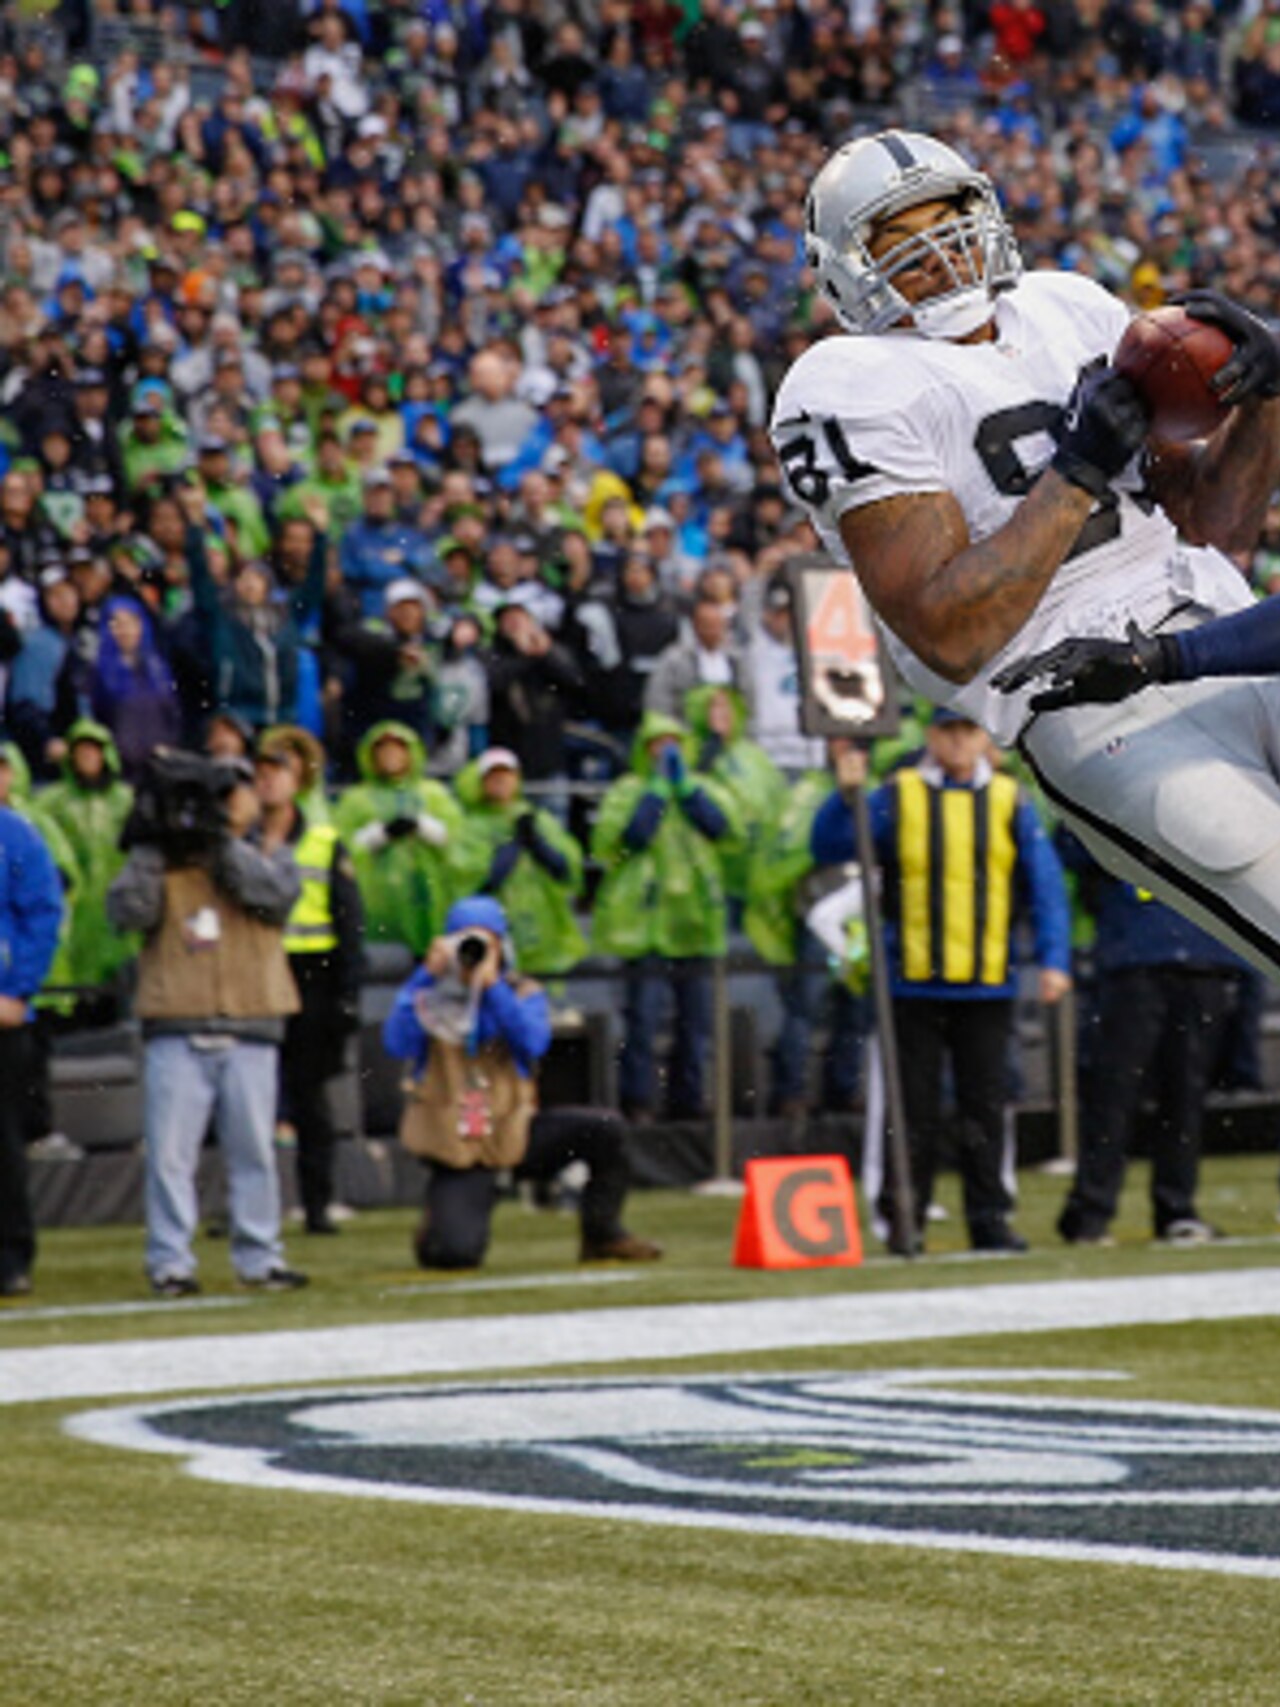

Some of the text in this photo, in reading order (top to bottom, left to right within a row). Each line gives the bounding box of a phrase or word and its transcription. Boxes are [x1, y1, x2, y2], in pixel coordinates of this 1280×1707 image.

[778, 412, 878, 507] 81
[808, 570, 878, 662] 4
[772, 1167, 849, 1257] G
